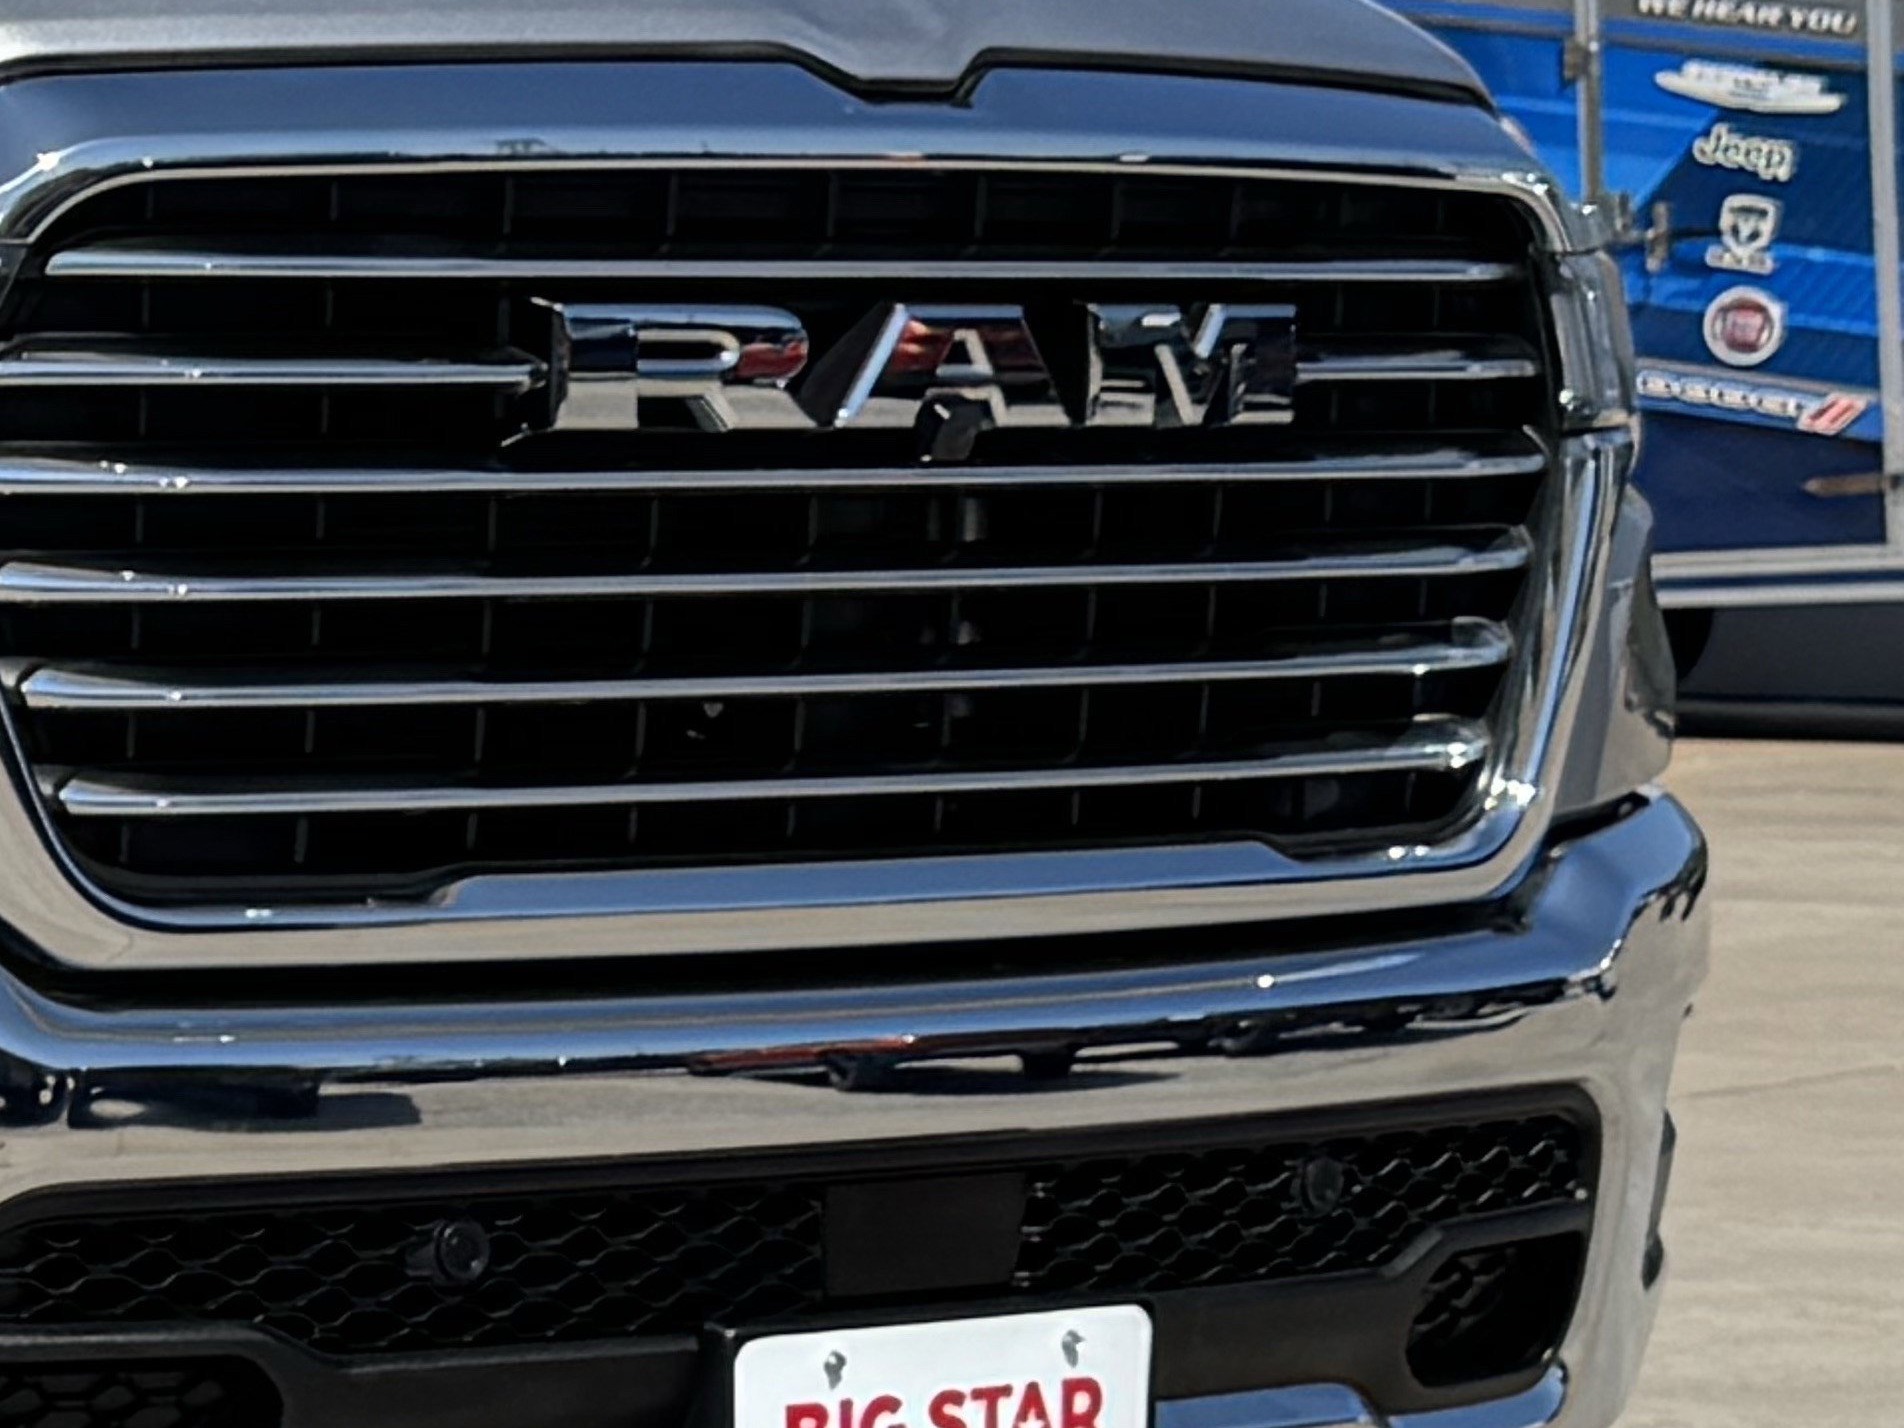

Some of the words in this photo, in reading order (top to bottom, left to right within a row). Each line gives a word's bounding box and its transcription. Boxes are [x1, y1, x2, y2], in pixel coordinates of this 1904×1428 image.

[1790, 6, 1858, 36] YOU
[1693, 123, 1797, 183] Jeep
[531, 297, 1298, 433] RAM
